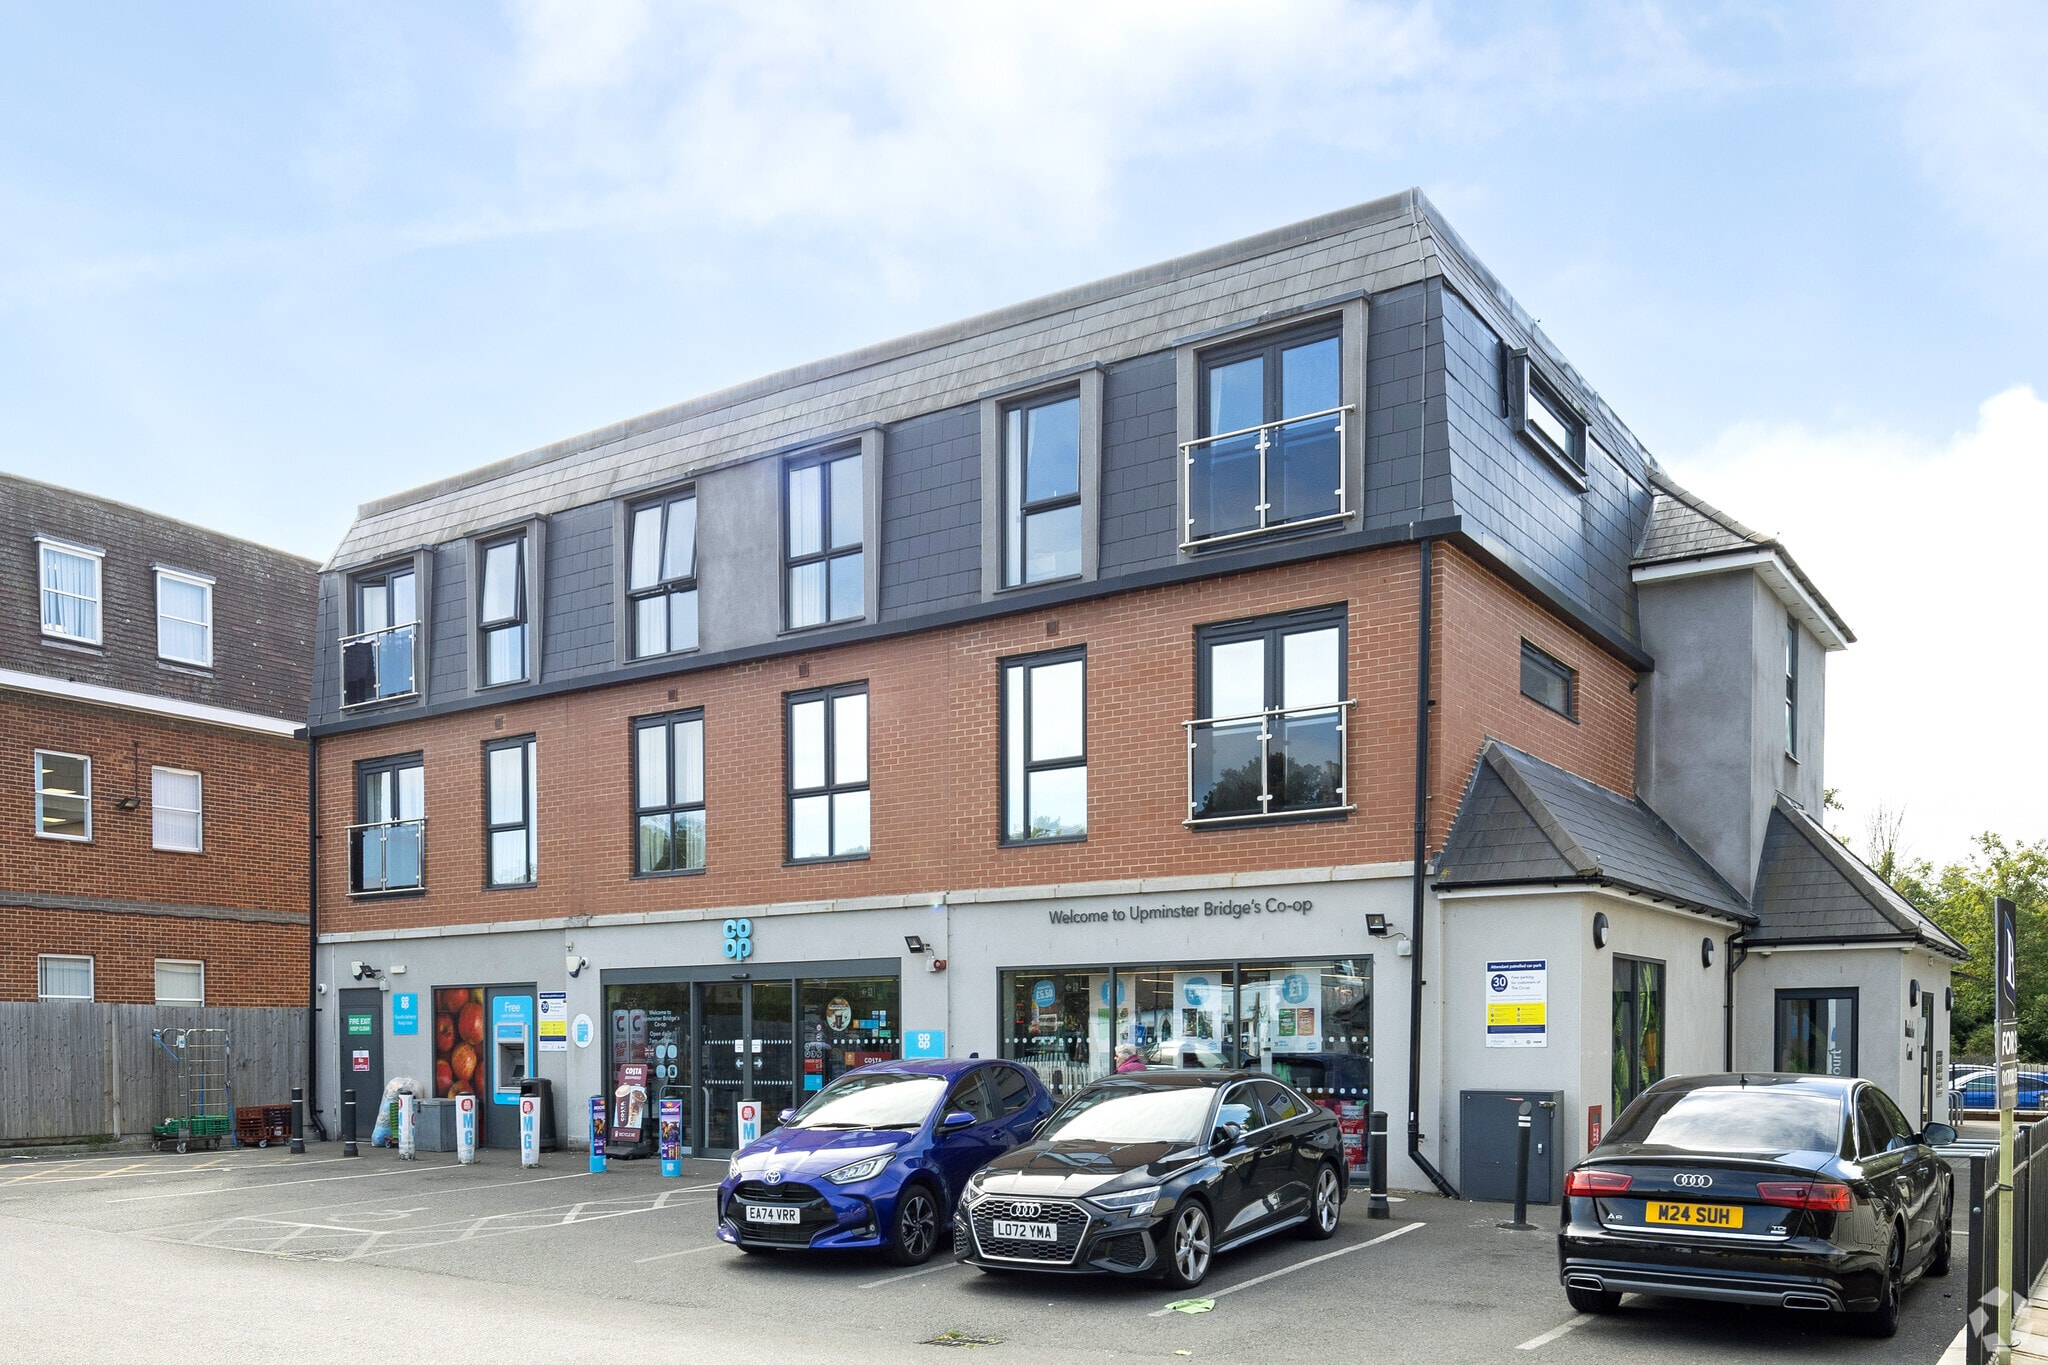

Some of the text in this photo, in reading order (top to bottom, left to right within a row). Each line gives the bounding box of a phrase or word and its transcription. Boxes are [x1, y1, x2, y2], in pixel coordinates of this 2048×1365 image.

[1049, 897, 1312, 925] Welcome to Upminster Bridge's Co-op
[1493, 977, 1506, 987] 30
[504, 1002, 521, 1012] Free
[2002, 1030, 2014, 1056] FOR
[1830, 1049, 1842, 1075] ourt
[750, 1208, 796, 1221] EA74 VRR
[1658, 1204, 1730, 1225] M24 SUH
[998, 1223, 1052, 1239] LO72 YMA
